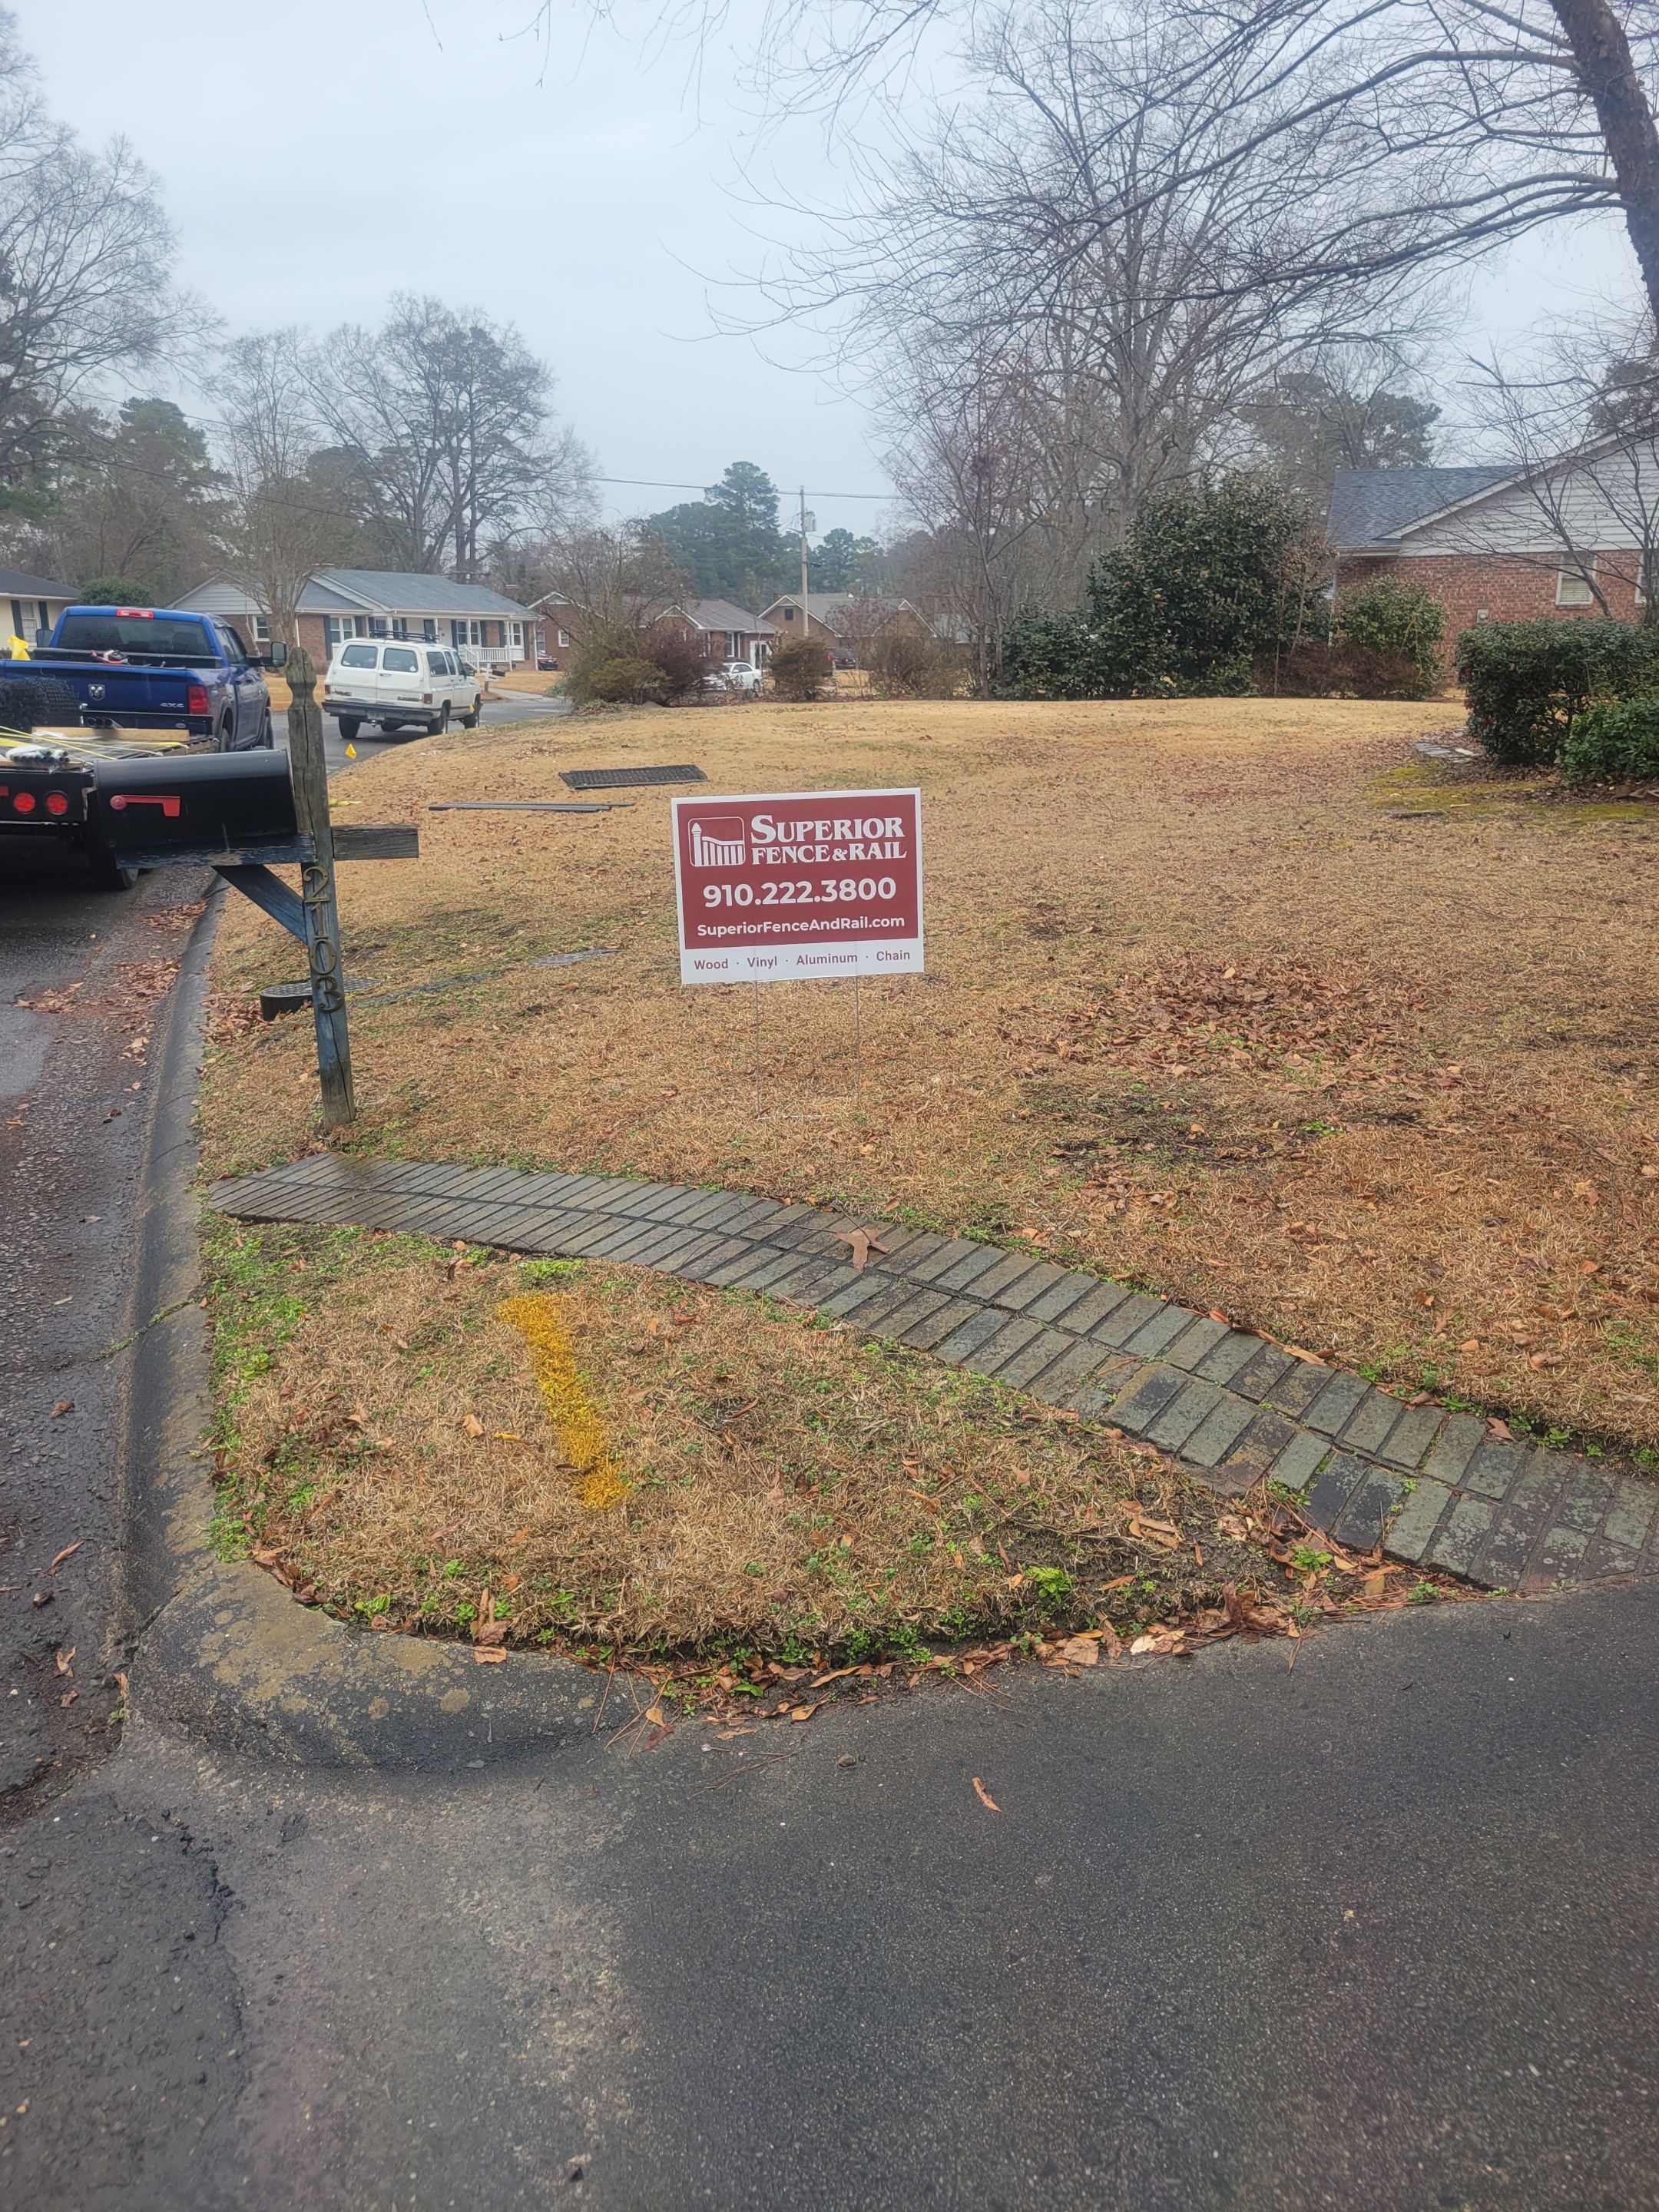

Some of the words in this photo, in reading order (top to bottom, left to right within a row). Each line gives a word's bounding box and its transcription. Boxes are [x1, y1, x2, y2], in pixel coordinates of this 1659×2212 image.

[750, 814, 906, 844] SUPERIOR
[702, 876, 896, 908] 910.222.3800
[303, 866, 345, 1013] 2103
[697, 916, 906, 938] SuperiorFenceAndRail.com
[694, 959, 729, 970] Wood
[747, 955, 778, 969] Vinyl
[796, 952, 858, 965] Aluminum
[876, 949, 911, 962] Chain
